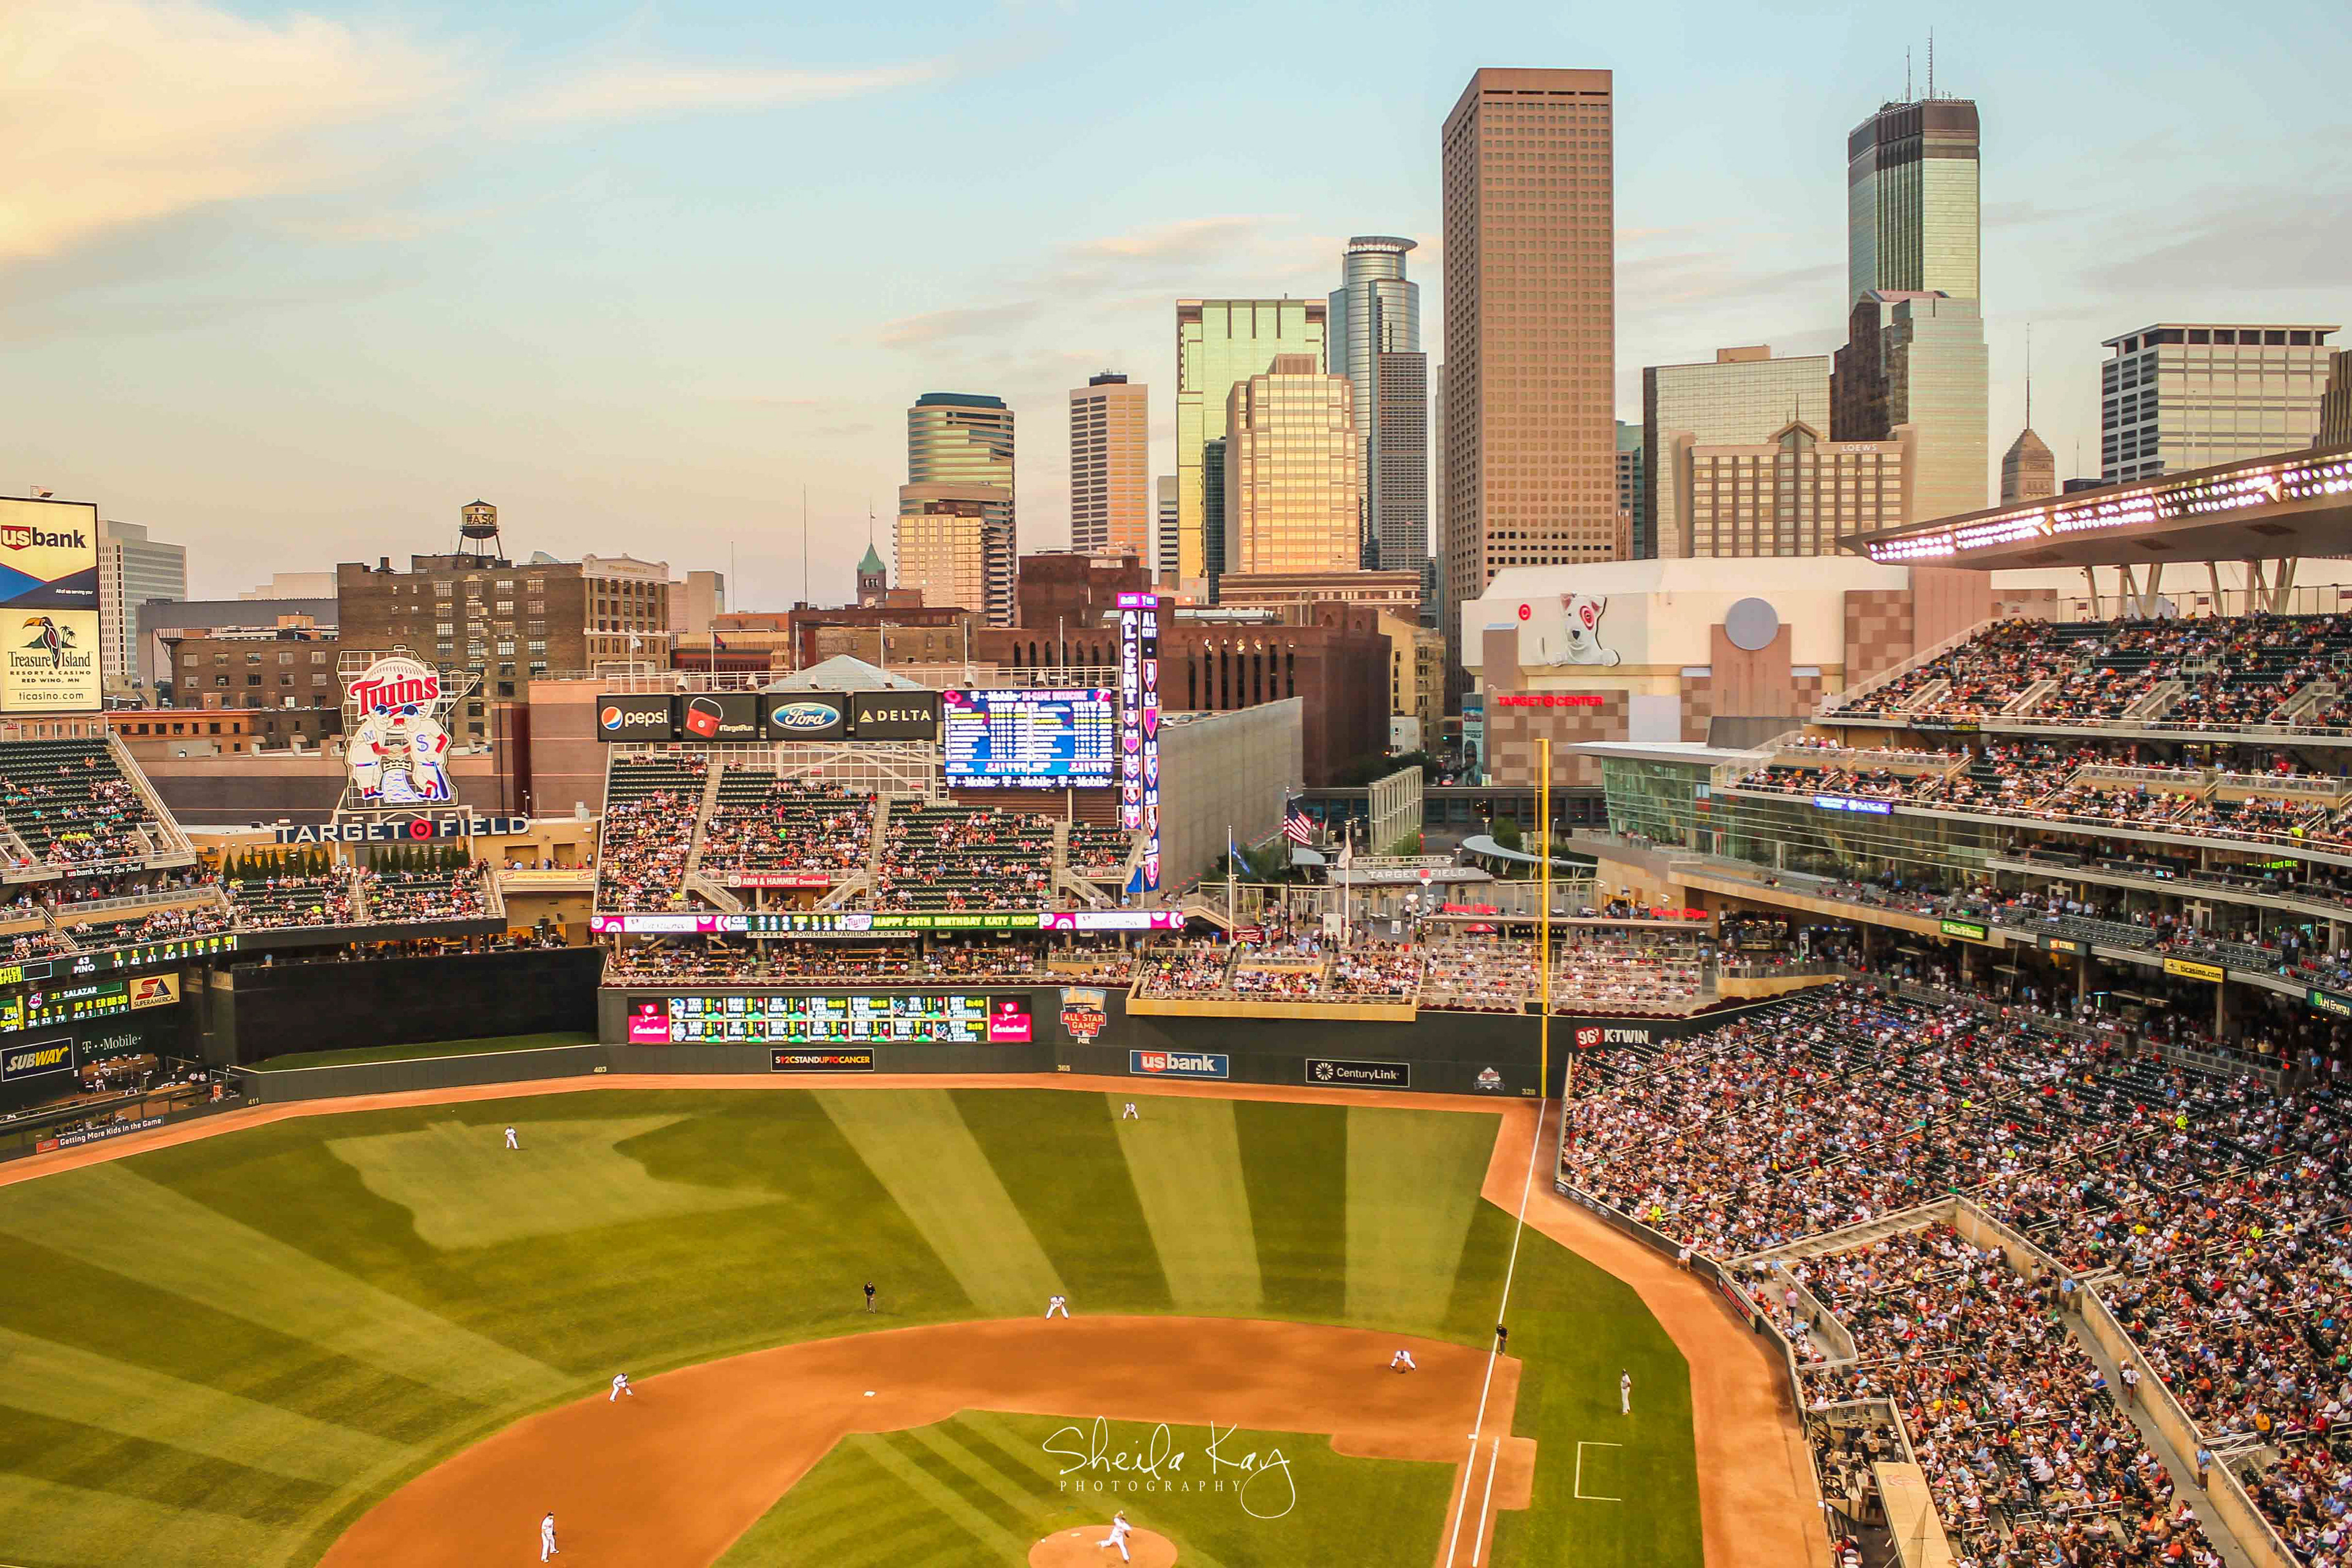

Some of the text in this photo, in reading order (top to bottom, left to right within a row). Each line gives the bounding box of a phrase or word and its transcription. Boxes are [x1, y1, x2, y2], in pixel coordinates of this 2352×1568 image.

[8, 650, 91, 667] Treasure Island
[18, 691, 85, 700] ticasino.com
[349, 674, 439, 718] Twins
[1498, 696, 1604, 707] TARGET CENTER
[624, 709, 668, 728] pepsi
[785, 706, 827, 726] Ford
[876, 709, 932, 722] DELTA
[719, 724, 754, 733] #TargetRun
[276, 816, 530, 844] TARGET FIELD
[96, 866, 113, 876] Home
[113, 865, 125, 874] Run
[1369, 869, 1467, 879] TARGET FIELD
[742, 877, 758, 886] ARM
[847, 916, 870, 928] Twins
[872, 916, 905, 927] HAPPY
[934, 916, 982, 926] BIRTHDAY
[984, 916, 1009, 926] KATY
[163, 952, 176, 960] 4.0
[74, 964, 96, 974] PINO
[2180, 963, 2222, 979] ticasino.com
[62, 986, 97, 998] SALAZAR
[56, 1005, 63, 1014] T
[74, 1002, 83, 1011] IP
[96, 999, 107, 1008] ER
[134, 997, 175, 1008] SUPERAMERICA
[1082, 1014, 1104, 1023] STAR
[6, 1046, 69, 1072] SUBWAY
[1337, 1068, 1396, 1080] CenturyLink
[248, 1097, 260, 1106] 411
[60, 1117, 162, 1147] Getting More Kids the Game
